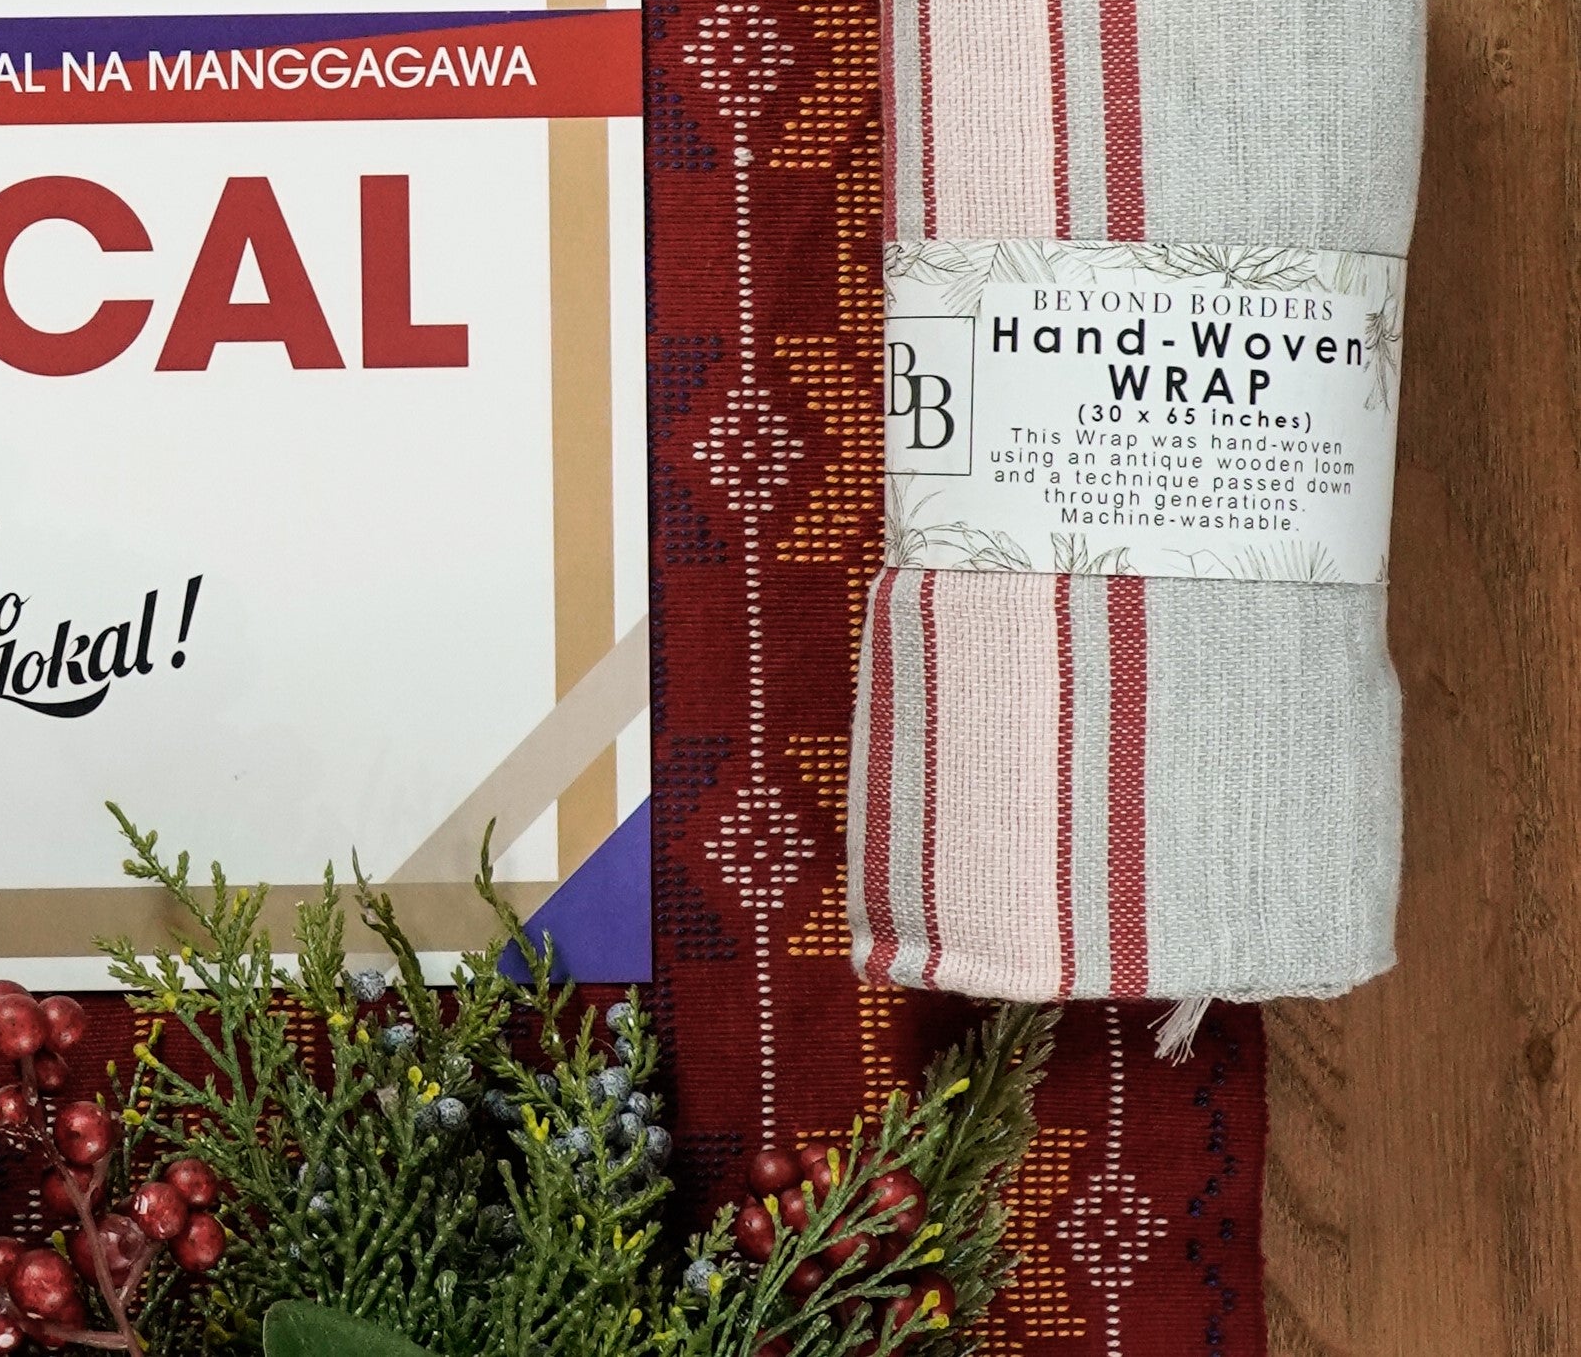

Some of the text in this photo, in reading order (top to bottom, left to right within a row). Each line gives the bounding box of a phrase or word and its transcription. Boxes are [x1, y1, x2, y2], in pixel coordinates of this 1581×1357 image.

[62, 50, 132, 92] NA
[148, 45, 537, 92] MANGGAGAWA
[1033, 290, 1334, 321] BEYOND BORDERS
[993, 317, 1362, 366] Hand-Woven
[887, 342, 955, 450] BB
[1108, 364, 1270, 405] WRAP
[1078, 405, 1313, 433] (30 x 65 inches)
[1012, 428, 1342, 455] This Wrap was hand-woven
[990, 449, 1355, 474] using an antique wooden loom
[994, 469, 1352, 494] and a technique passed down
[1044, 488, 1307, 513] through generations.
[1060, 508, 1300, 532] Machine-washable.
